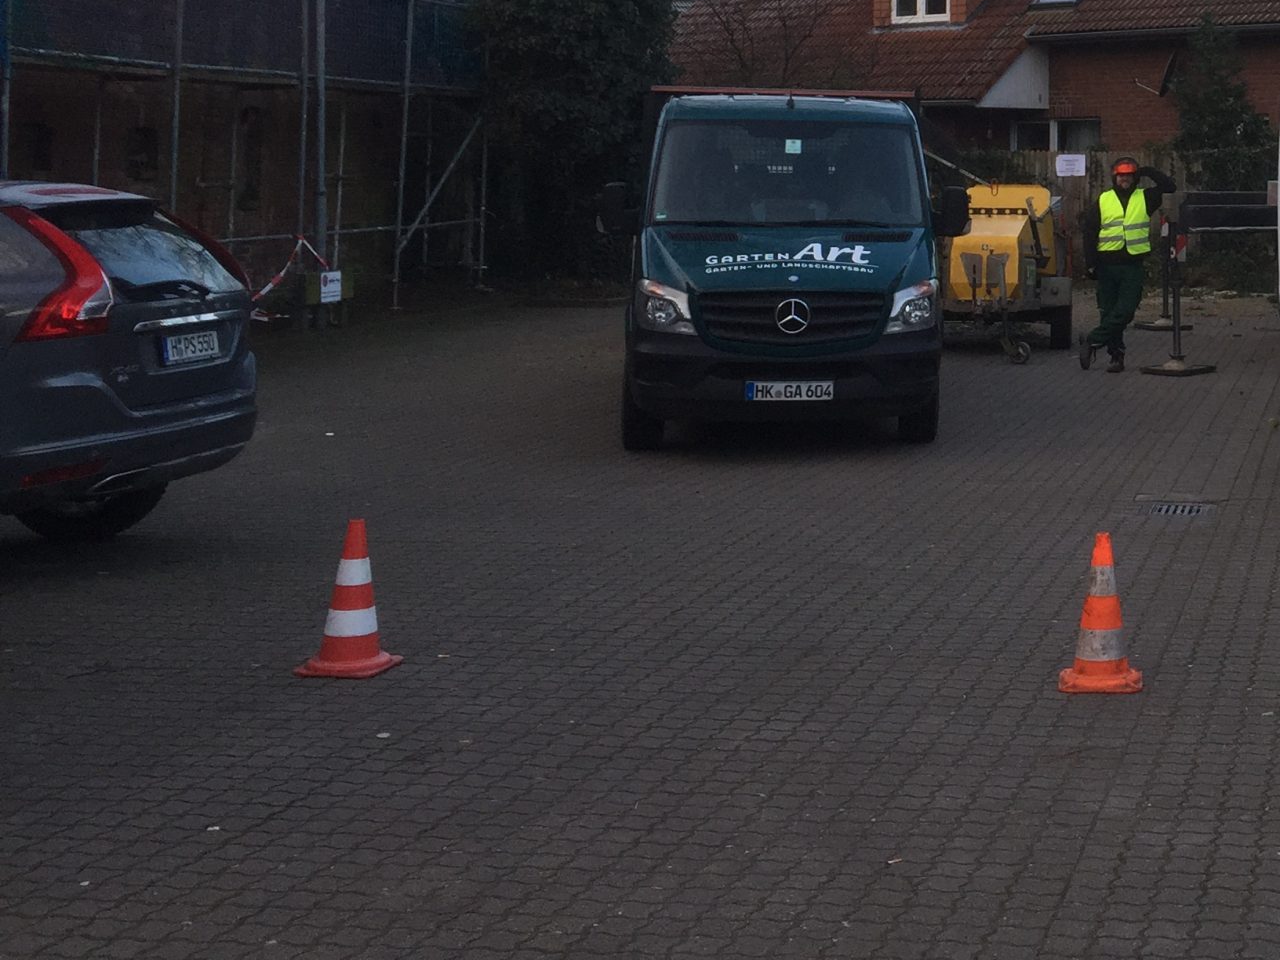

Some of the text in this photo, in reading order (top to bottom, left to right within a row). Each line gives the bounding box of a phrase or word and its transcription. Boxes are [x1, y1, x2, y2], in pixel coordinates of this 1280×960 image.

[705, 243, 871, 265] GARTEN Art
[755, 384, 832, 399] HK GA 604
